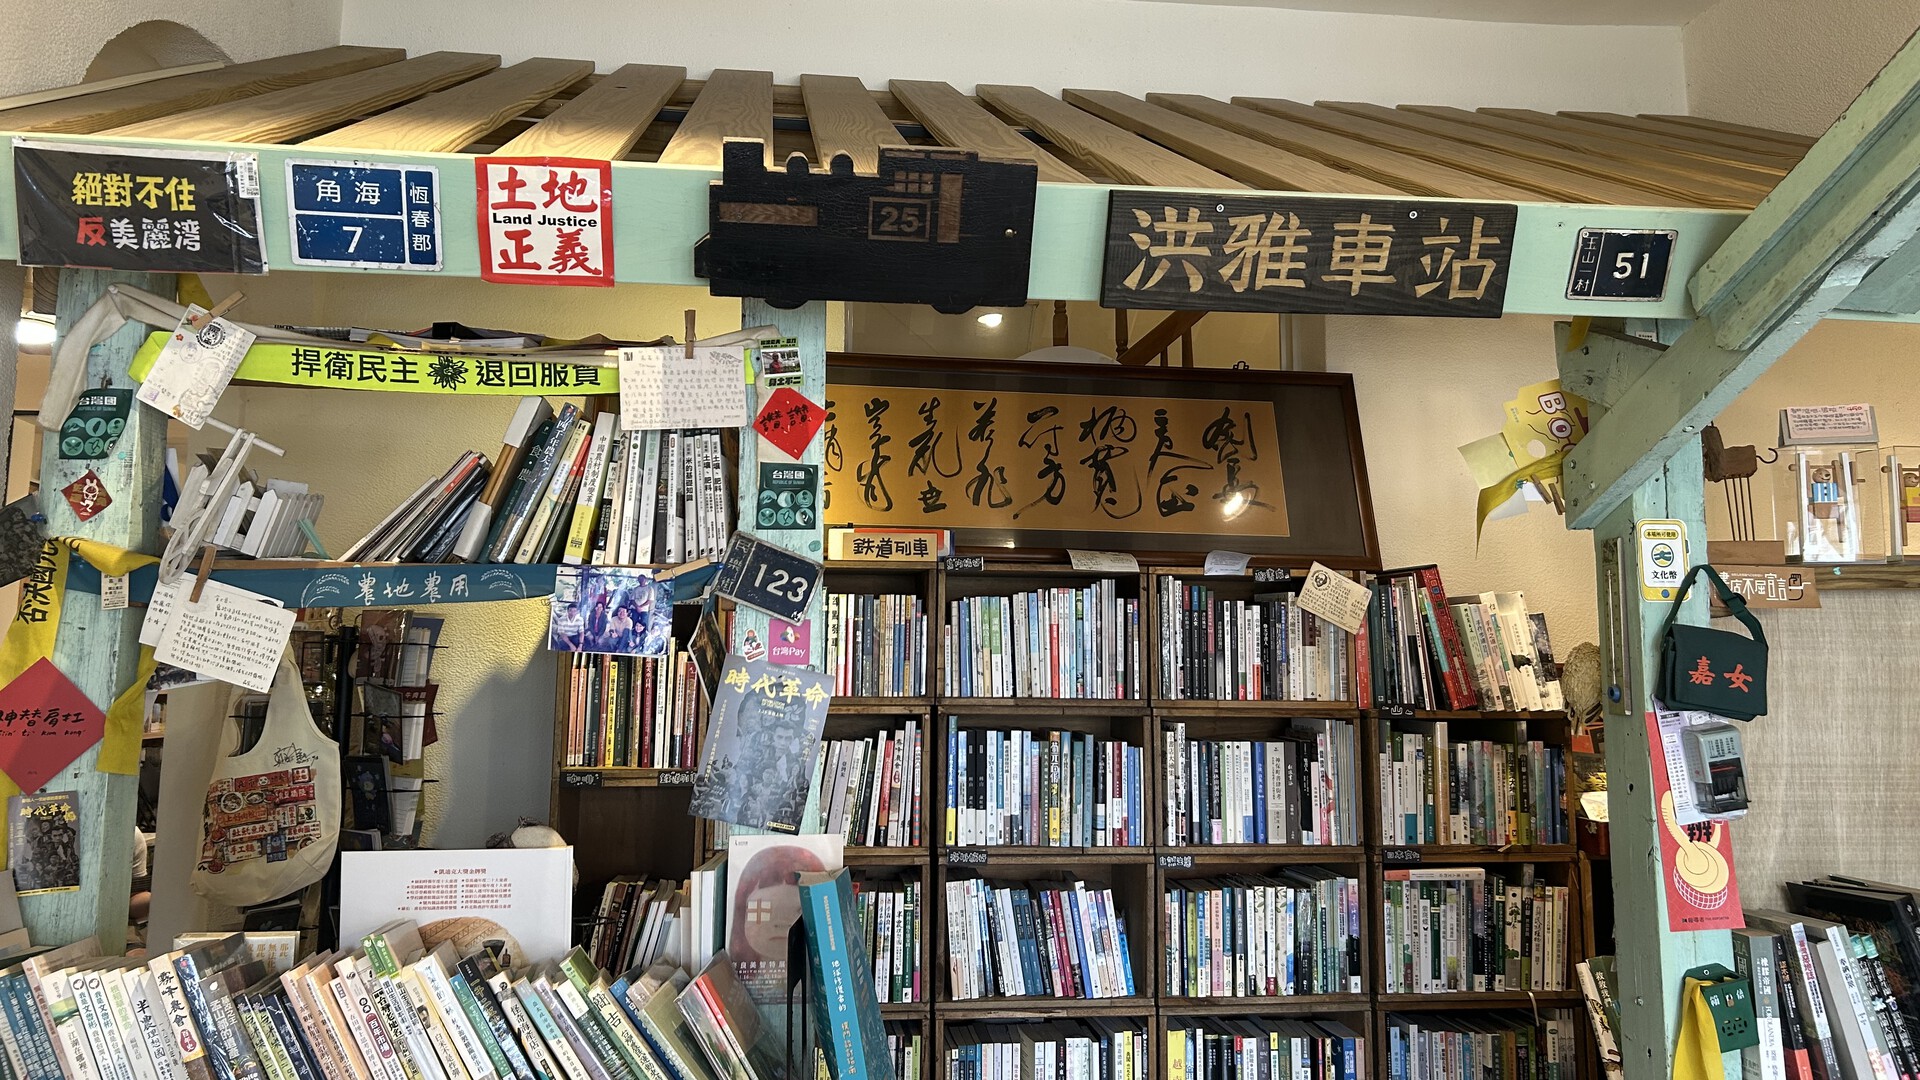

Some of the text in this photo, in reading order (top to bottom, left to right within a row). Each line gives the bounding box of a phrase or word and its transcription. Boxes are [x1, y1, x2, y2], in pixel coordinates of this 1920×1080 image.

[72, 172, 196, 212] 絕對不住
[316, 179, 381, 205] 角海
[491, 166, 598, 213] 土地
[76, 214, 202, 252] 反美麗湾
[493, 212, 598, 228] Land Justice
[879, 206, 920, 232] 25
[341, 225, 363, 255] 7
[497, 227, 602, 276] 正義
[1122, 206, 1500, 301] 洪雅車站
[1614, 252, 1651, 281] 51
[291, 347, 420, 384] 捍衛民主
[79, 396, 117, 406] 台灣國
[772, 470, 805, 480] 台灣國
[853, 537, 929, 558] 鉄道列車
[355, 571, 470, 607] 農地農用
[753, 562, 809, 603] 123
[1651, 570, 1678, 579] 文化幣
[772, 646, 806, 657] 台灣Pay
[724, 666, 829, 711] 時代革命
[1688, 656, 1753, 693] 嘉女
[20, 803, 71, 818] 時代革命
